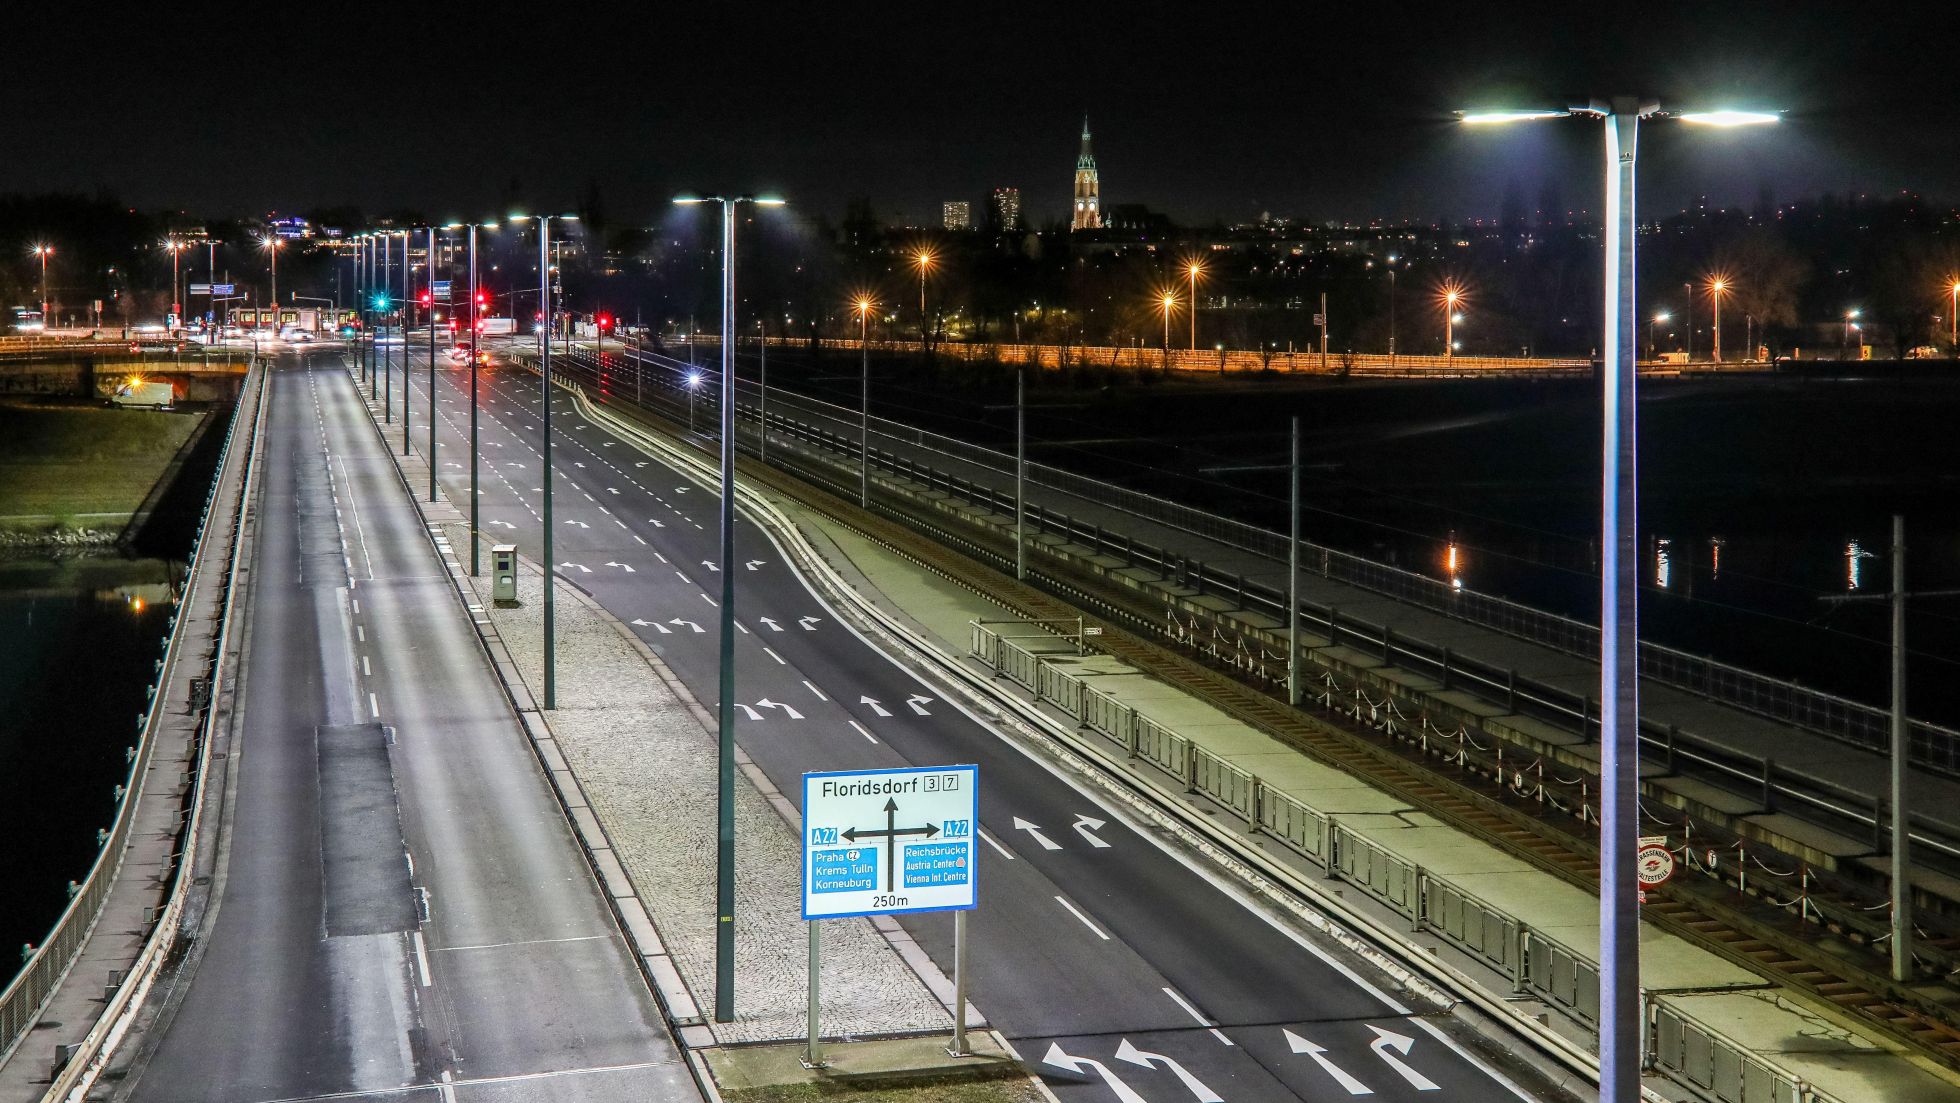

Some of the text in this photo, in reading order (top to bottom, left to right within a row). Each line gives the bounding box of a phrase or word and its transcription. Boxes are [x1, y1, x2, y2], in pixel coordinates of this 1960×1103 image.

[823, 778, 918, 797] Floridsdorf
[945, 821, 968, 836] A22
[813, 828, 837, 844] A22
[816, 852, 857, 862] Praha CZ
[906, 846, 966, 857] Reichsbrücke
[816, 864, 873, 876] Krems Tulln
[906, 860, 956, 870] Austria Center
[816, 878, 871, 889] Korneuburg
[906, 872, 966, 884] Vienna Int. Centre
